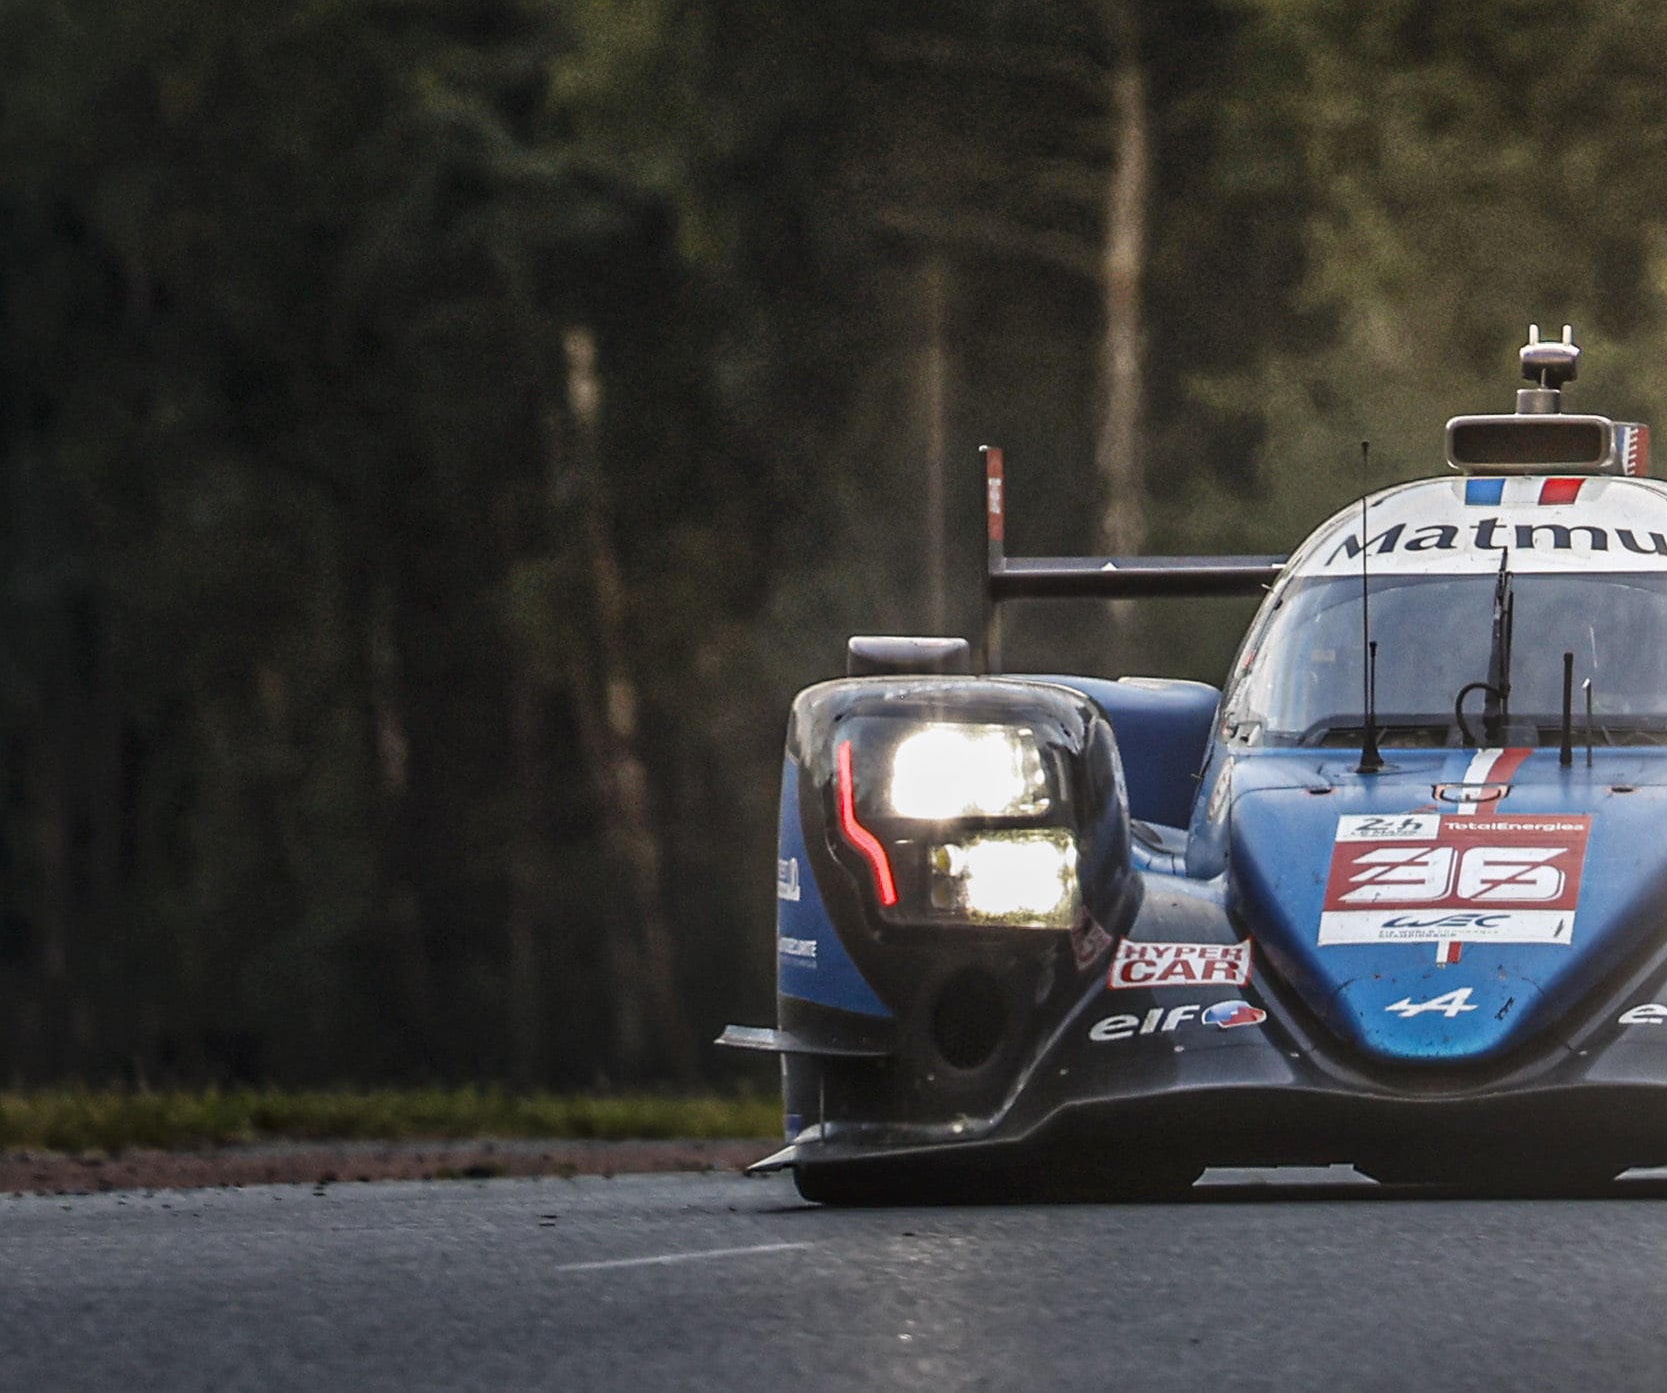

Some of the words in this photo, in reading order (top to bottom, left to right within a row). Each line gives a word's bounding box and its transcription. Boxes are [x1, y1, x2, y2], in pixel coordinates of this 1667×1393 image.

[1445, 821, 1585, 832] TotalEnergies
[1337, 846, 1569, 903] 36
[1381, 913, 1512, 928] WEC
[1125, 945, 1243, 960] HYPER
[1121, 959, 1241, 983] CAR
